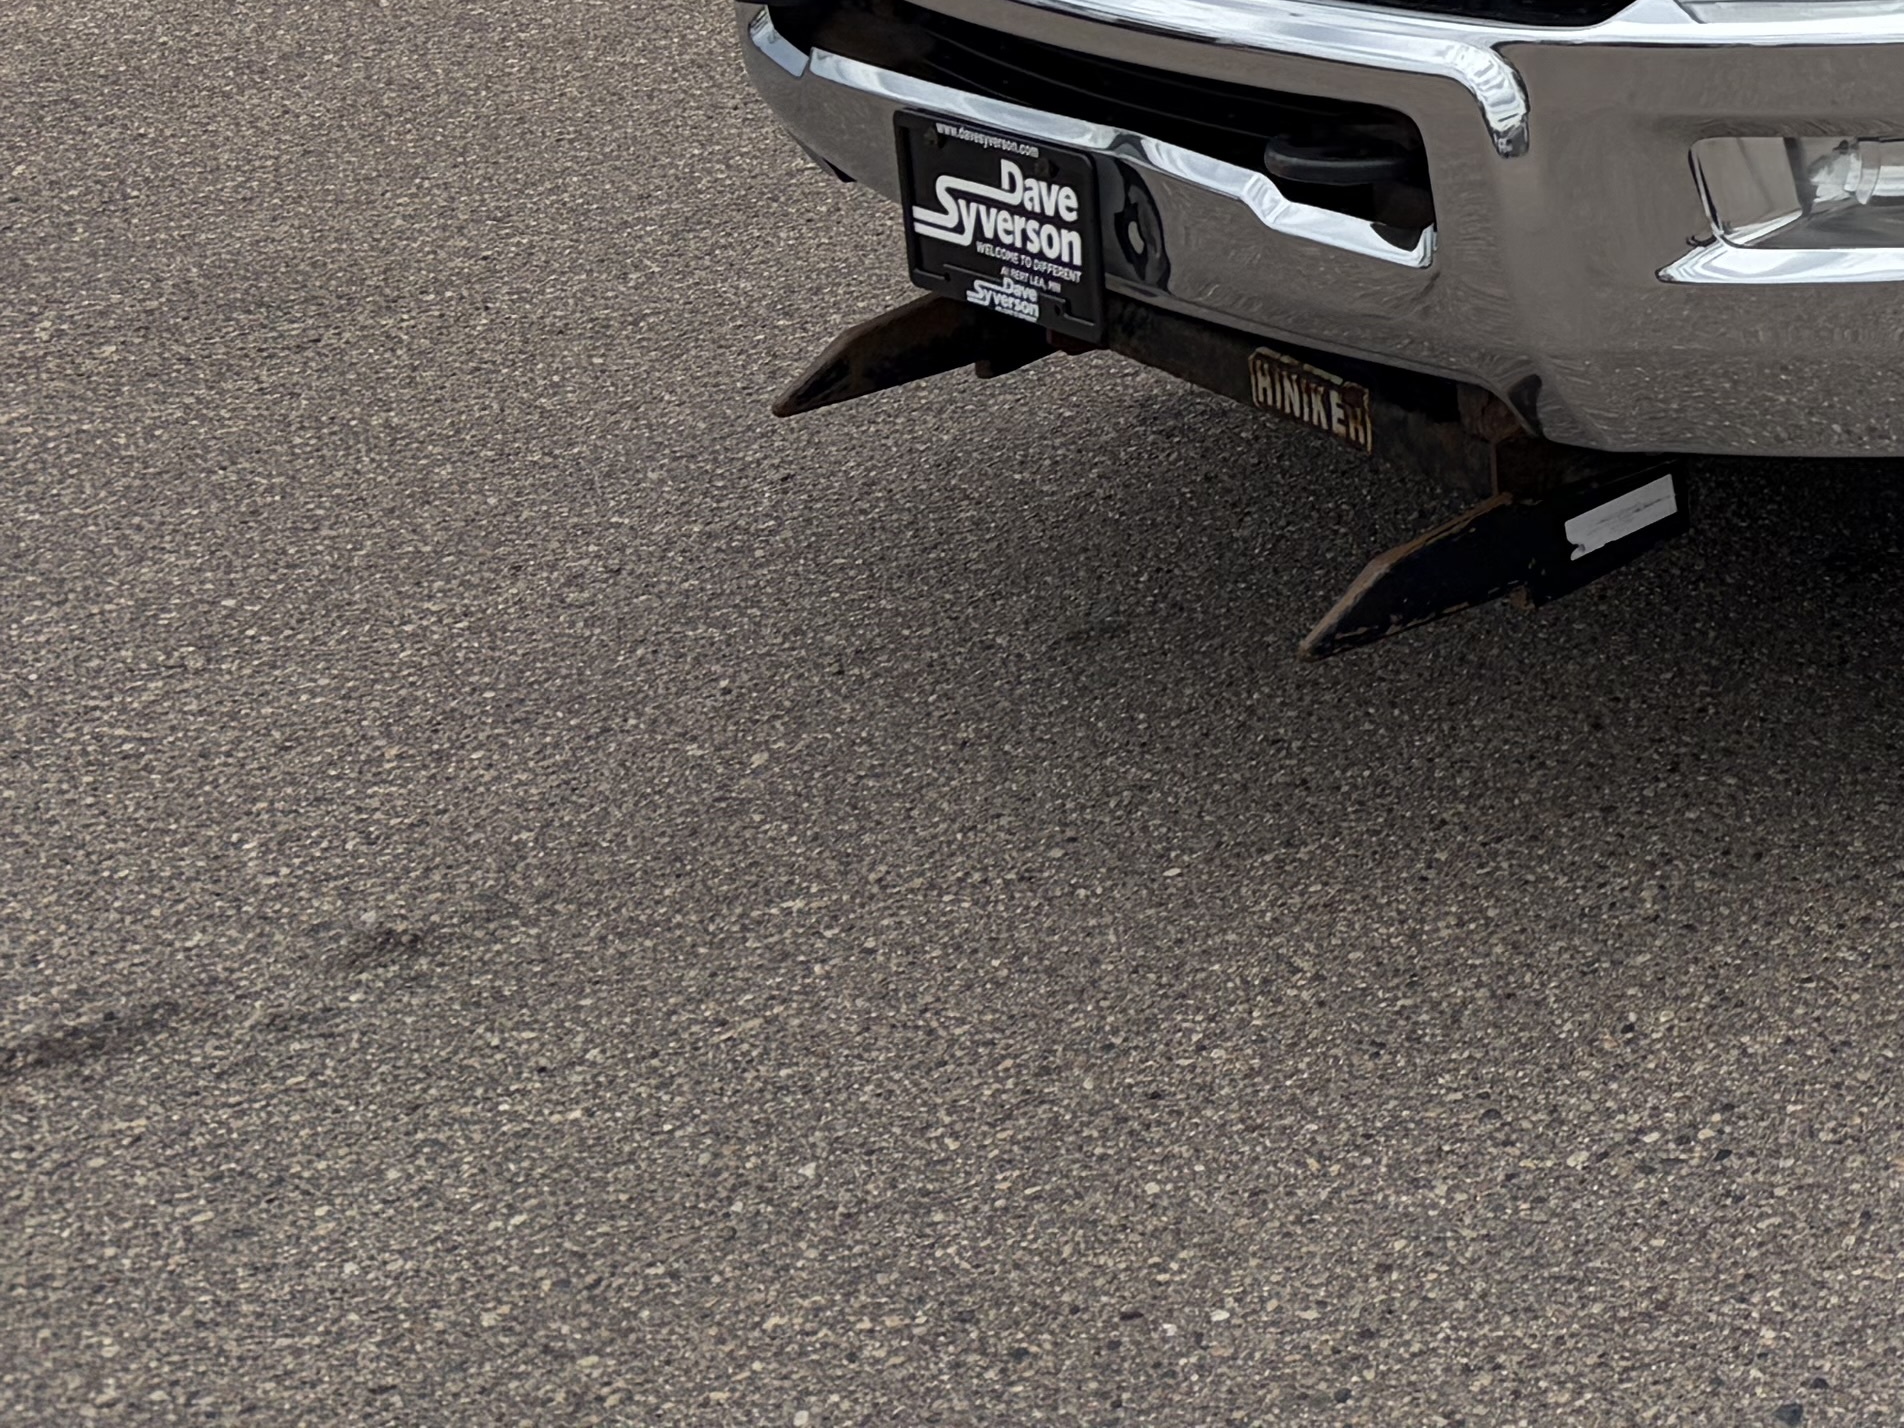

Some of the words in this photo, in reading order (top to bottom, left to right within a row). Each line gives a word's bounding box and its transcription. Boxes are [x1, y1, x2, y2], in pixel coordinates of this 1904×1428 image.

[1000, 158, 1079, 223] Dave
[911, 174, 1083, 267] Syverson
[975, 240, 1020, 265] WELCOME
[1020, 254, 1032, 269] TO
[1033, 258, 1083, 284] DIFFERENT
[965, 279, 1040, 319] Syverson
[1002, 276, 1038, 302] Dave
